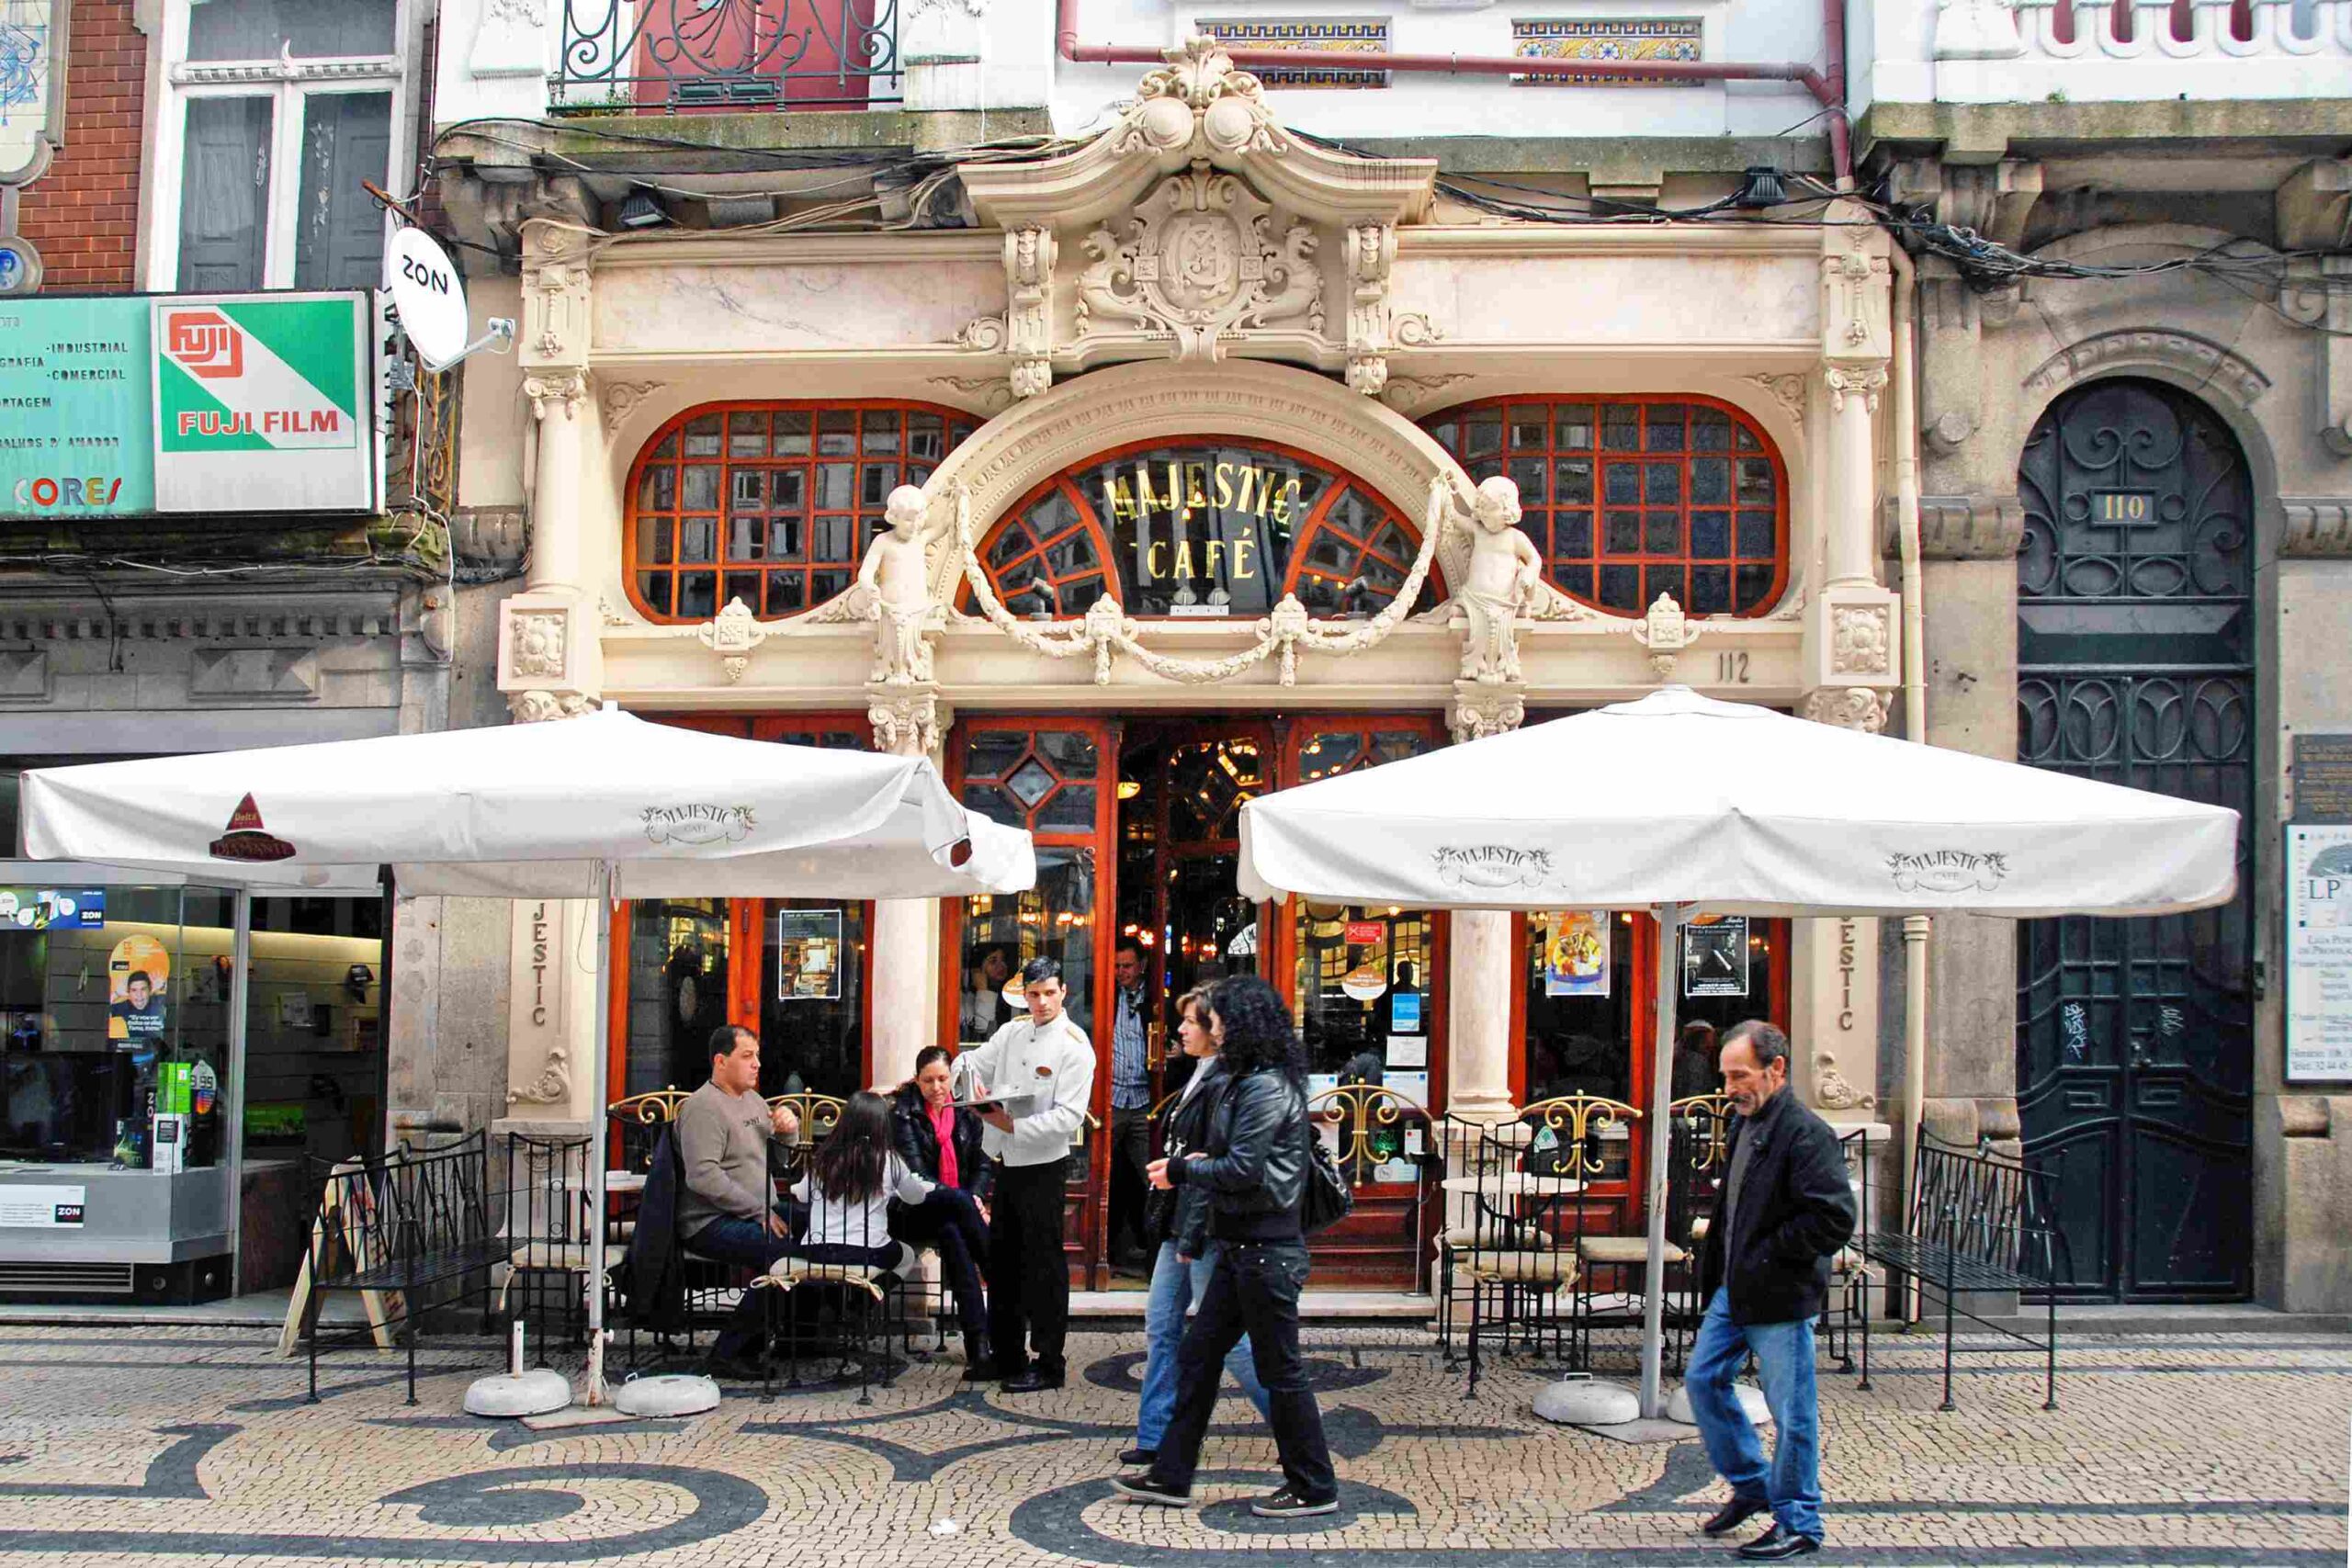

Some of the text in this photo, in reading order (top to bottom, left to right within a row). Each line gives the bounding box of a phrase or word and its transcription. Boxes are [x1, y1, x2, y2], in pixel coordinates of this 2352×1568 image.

[401, 254, 448, 296] ZON
[169, 313, 236, 370] FUJI
[178, 410, 339, 435] FUJI FILM
[1102, 462, 1302, 525] MAJESTIC
[2105, 493, 2145, 520] 110
[1147, 527, 1256, 580] CAFÉ
[1719, 651, 1749, 684] 112
[662, 803, 730, 824] MAJESTIC
[1456, 845, 1526, 867] MAJESTIC
[1910, 850, 1981, 872] MAJESTIC
[81, 910, 102, 919] ZON
[1839, 916, 1855, 1031] ESTIC
[57, 1207, 81, 1216] ZON
